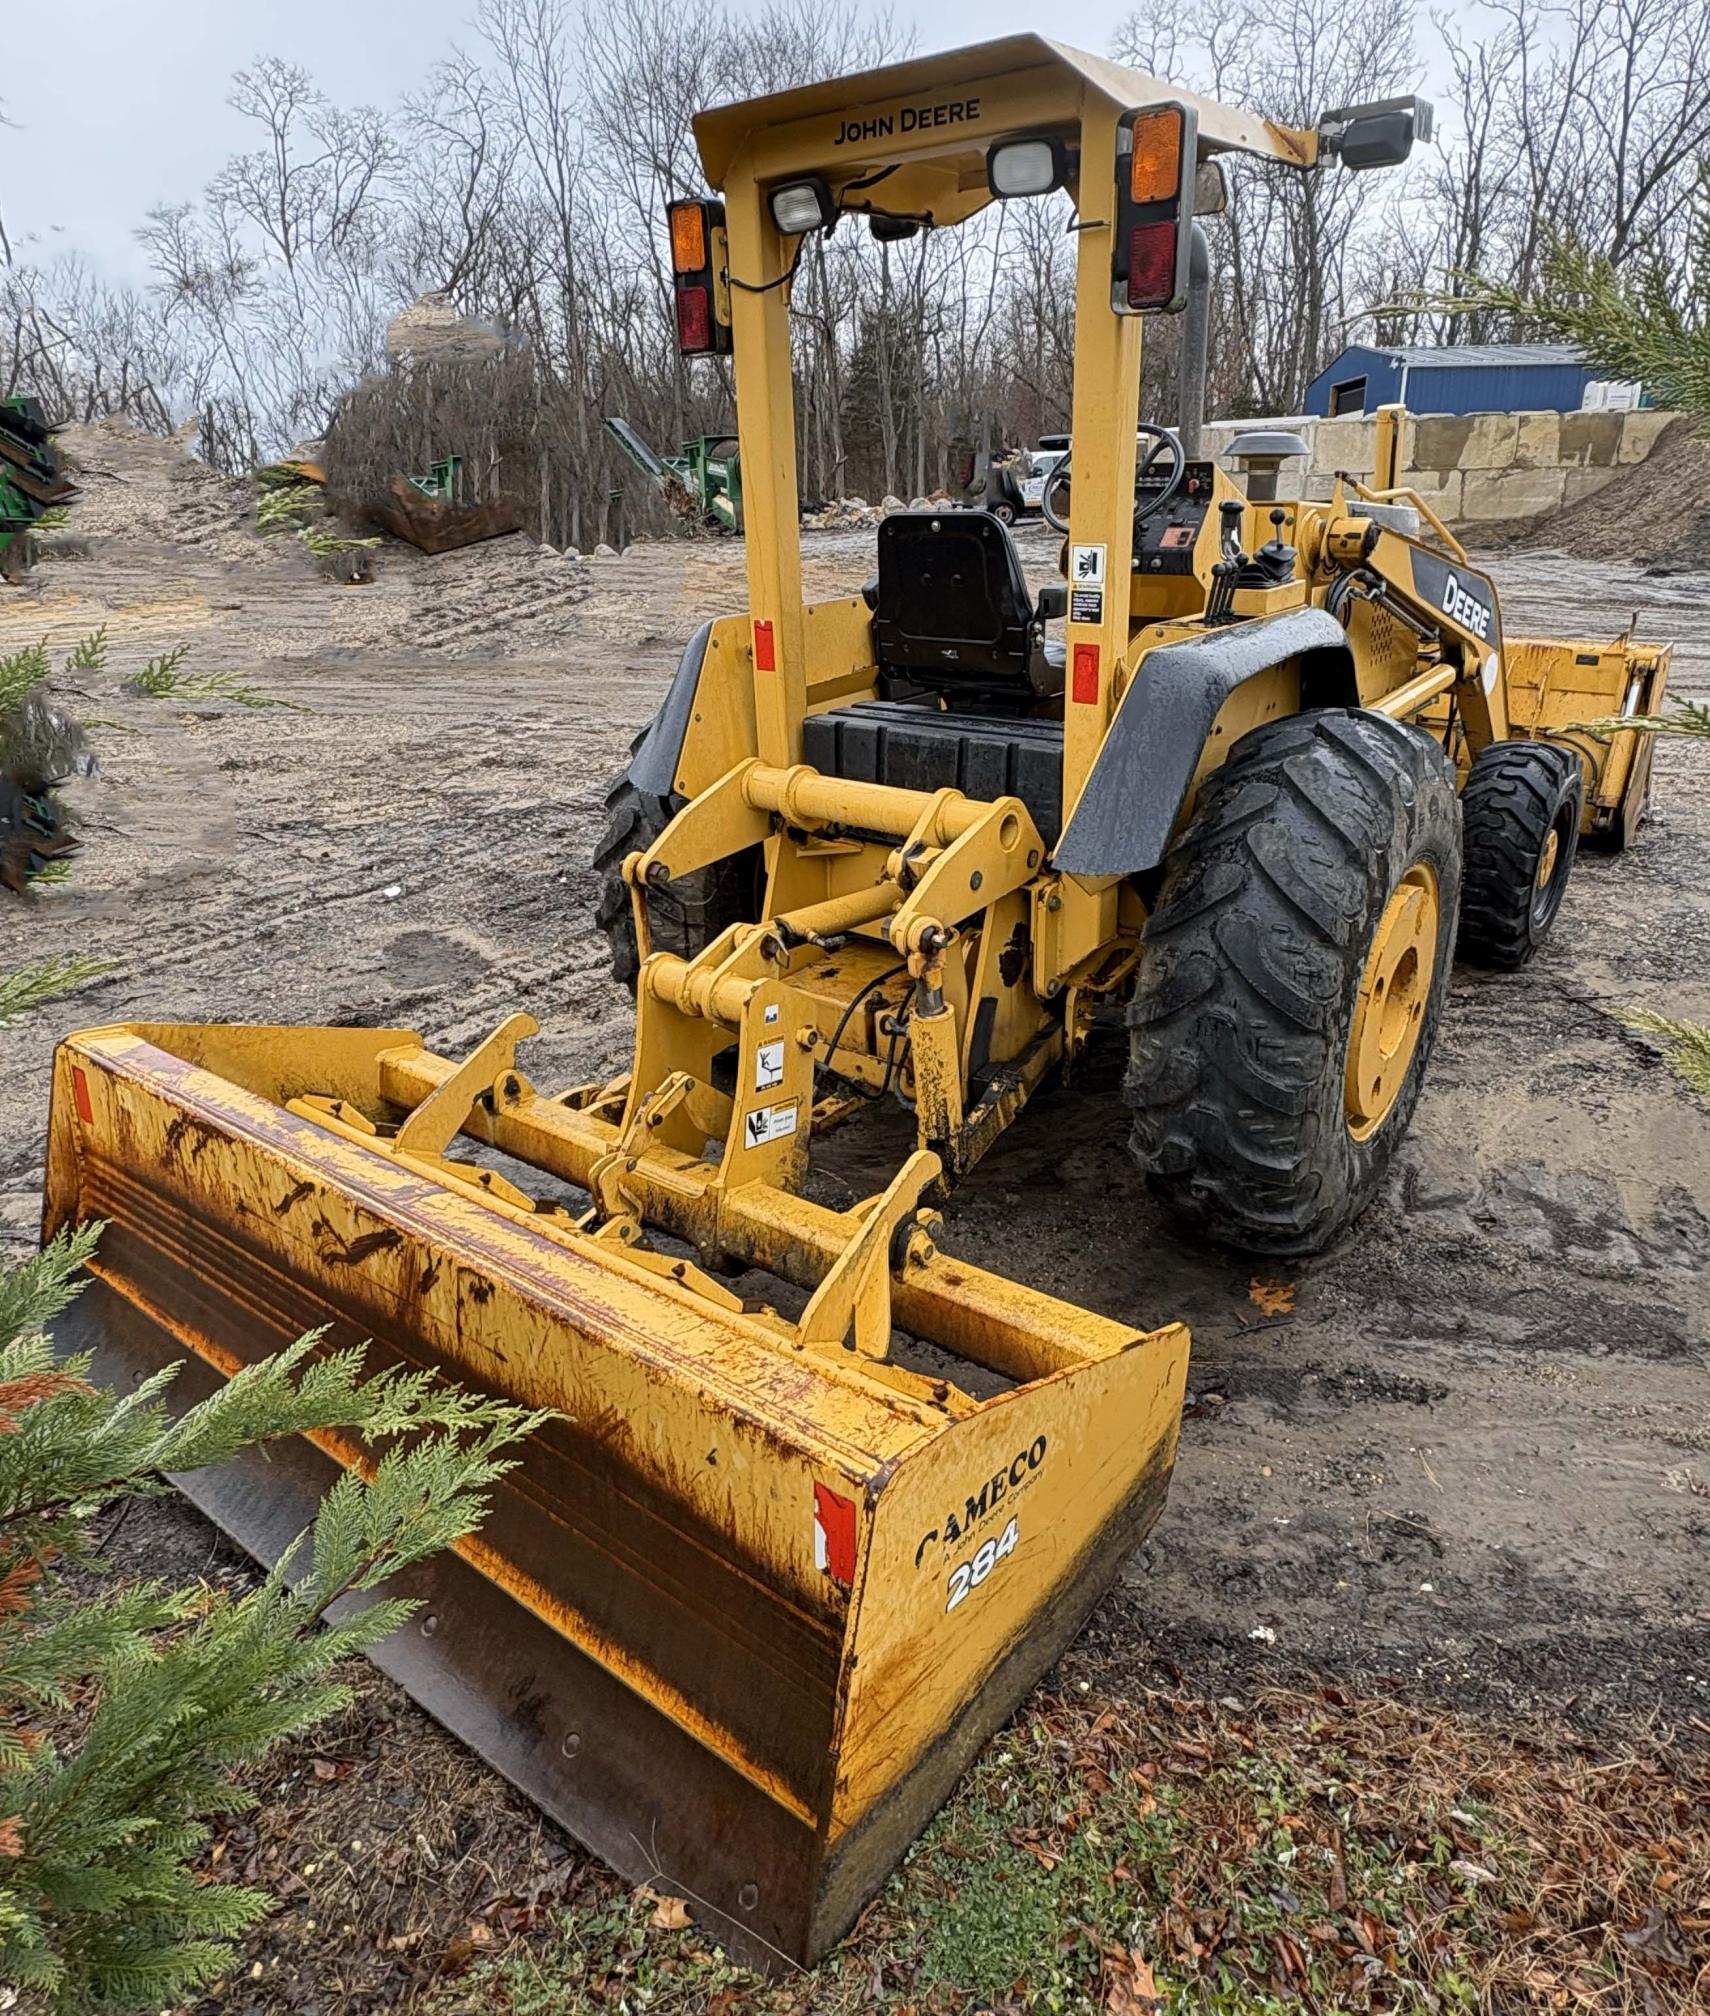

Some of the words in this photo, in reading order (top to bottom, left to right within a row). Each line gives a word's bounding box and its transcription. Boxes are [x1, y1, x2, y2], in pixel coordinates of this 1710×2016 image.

[834, 116, 893, 145] JOHN
[901, 98, 980, 132] DEERE
[1441, 573, 1491, 639] DEERE
[946, 1513, 1020, 1615] 284
